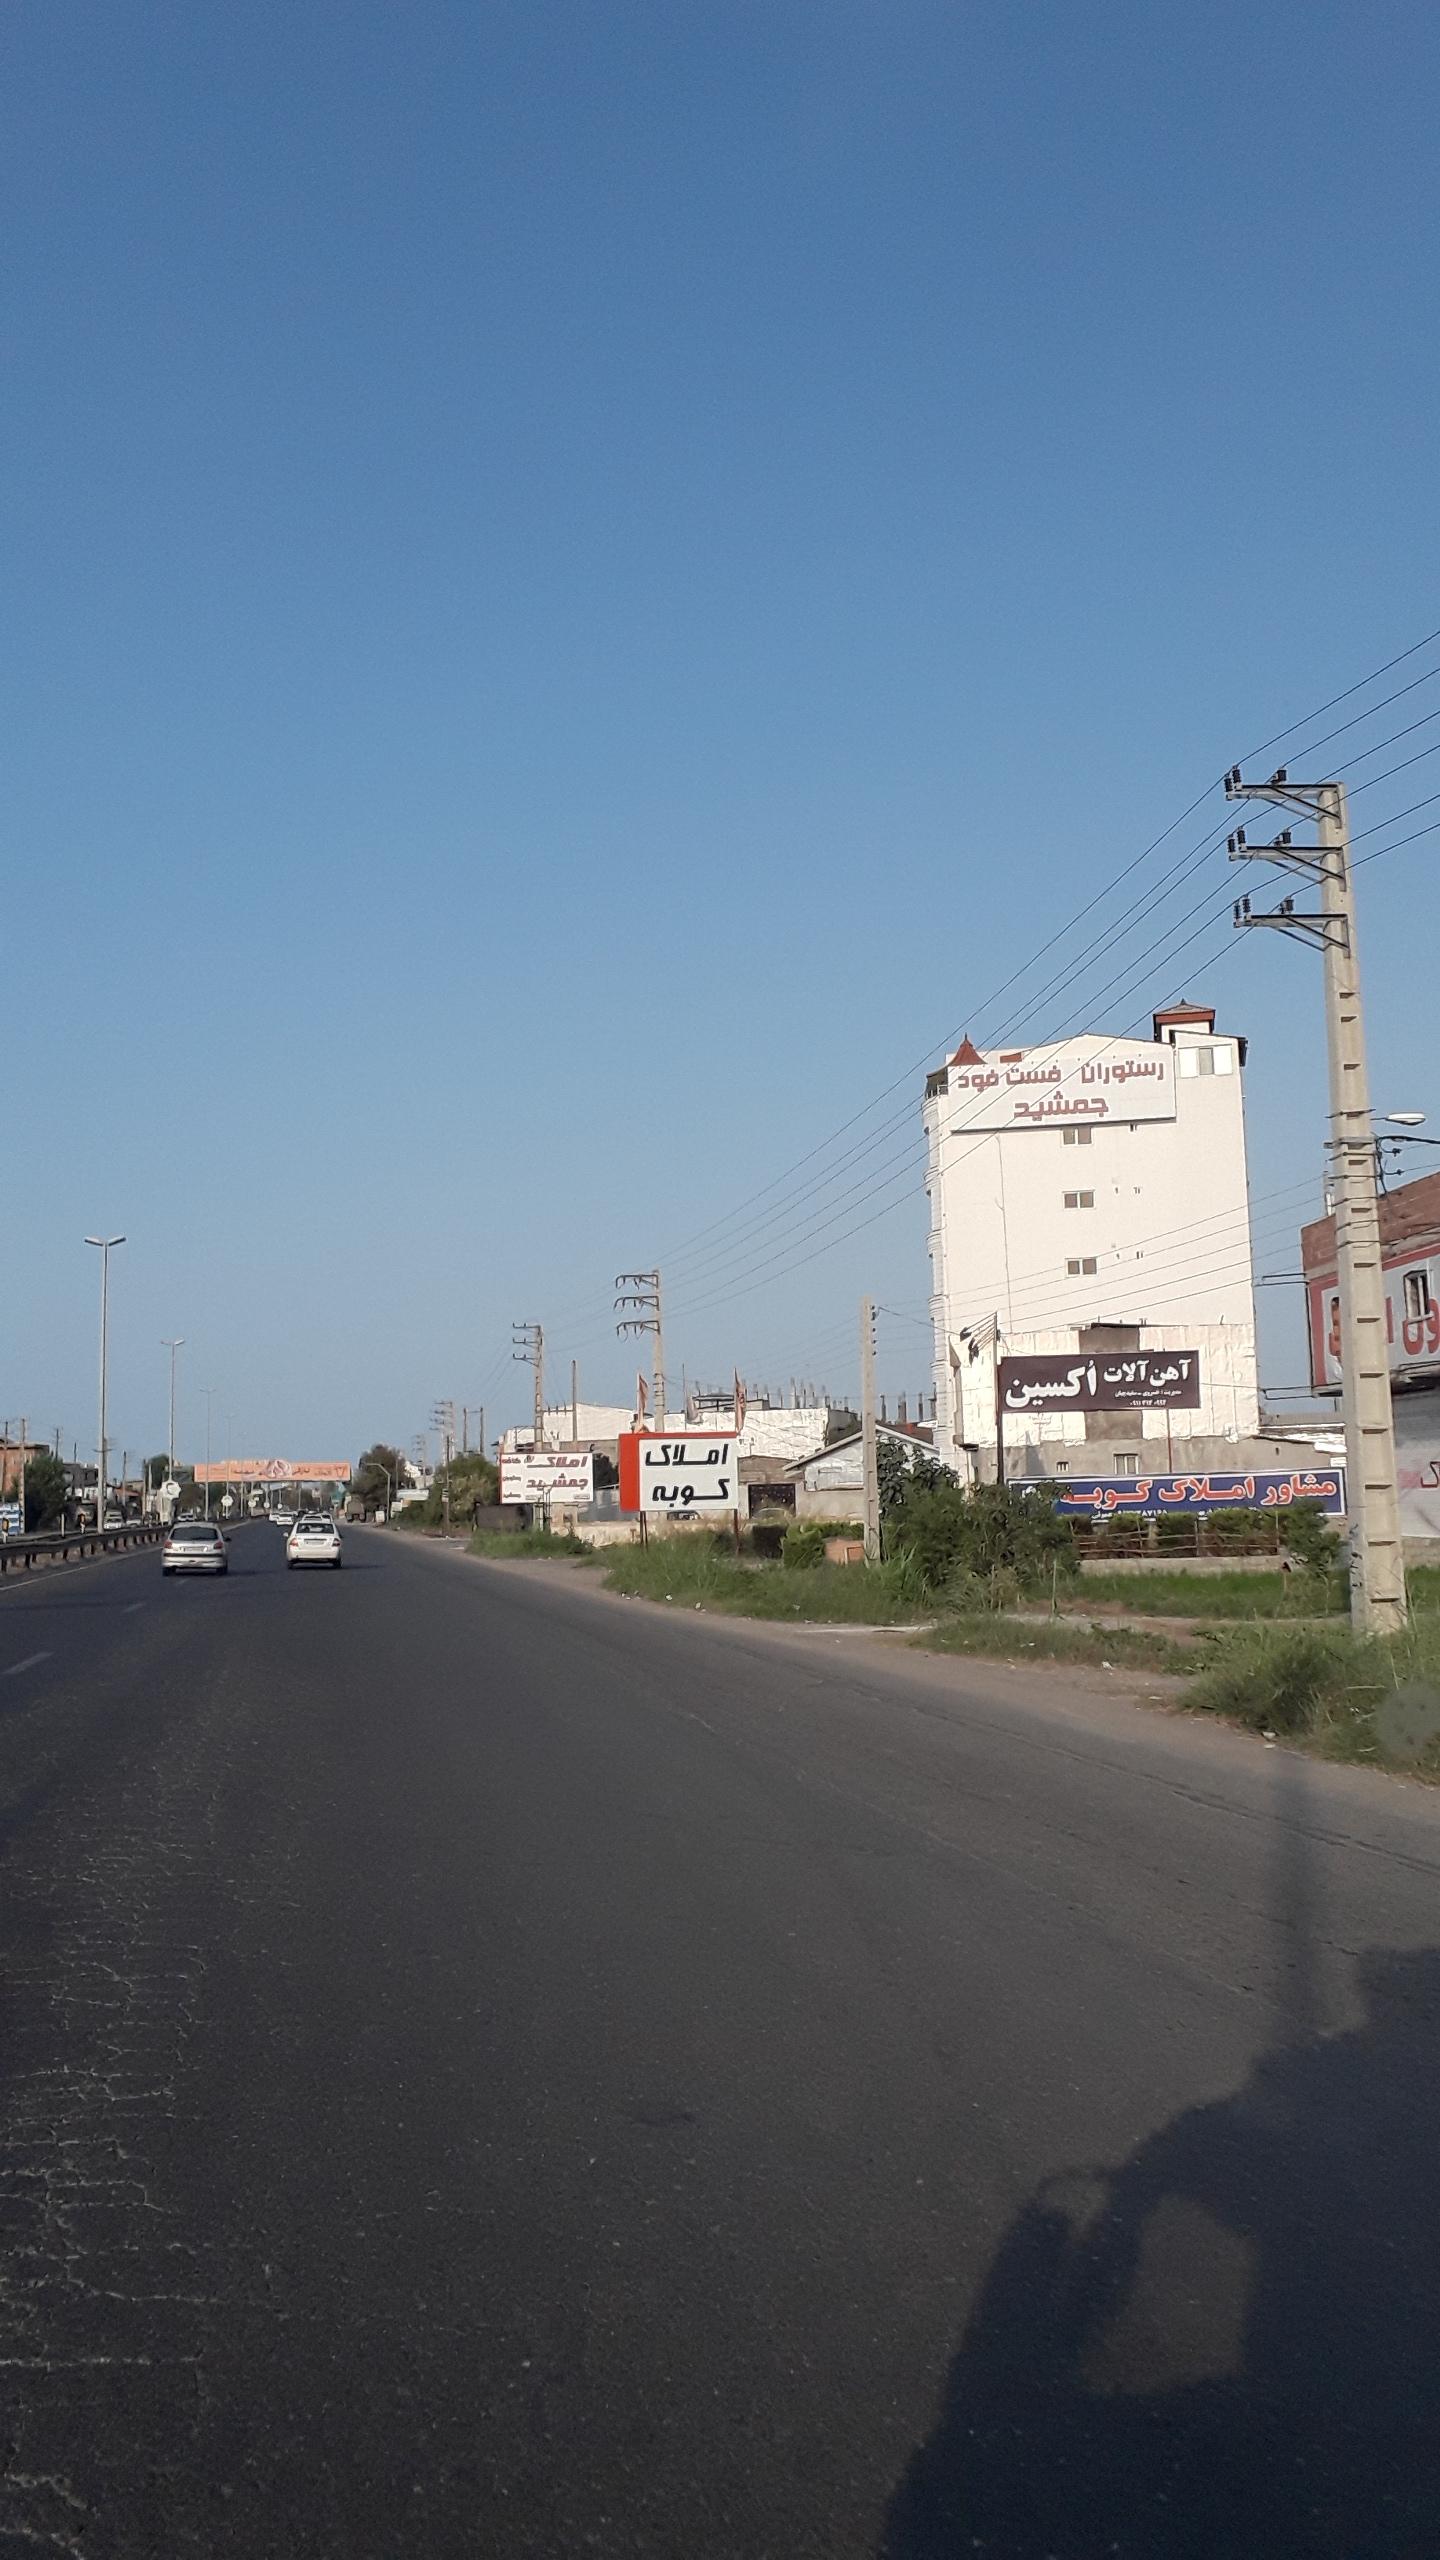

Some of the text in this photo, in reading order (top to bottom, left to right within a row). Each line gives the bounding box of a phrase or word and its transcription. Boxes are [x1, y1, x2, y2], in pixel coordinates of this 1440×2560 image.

[957, 1060, 1164, 1092] رستوران فست فود
[1013, 1091, 1109, 1121] جمشید
[1103, 1360, 1149, 1382] آلات
[1150, 1359, 1192, 1387] آهن
[526, 1456, 588, 1468] املاک
[645, 1443, 729, 1466] املاک
[526, 1473, 589, 1491] جمشید
[652, 1478, 730, 1507] کوبه
[1158, 1476, 1256, 1503] املاک
[1260, 1473, 1337, 1505] مشاور
